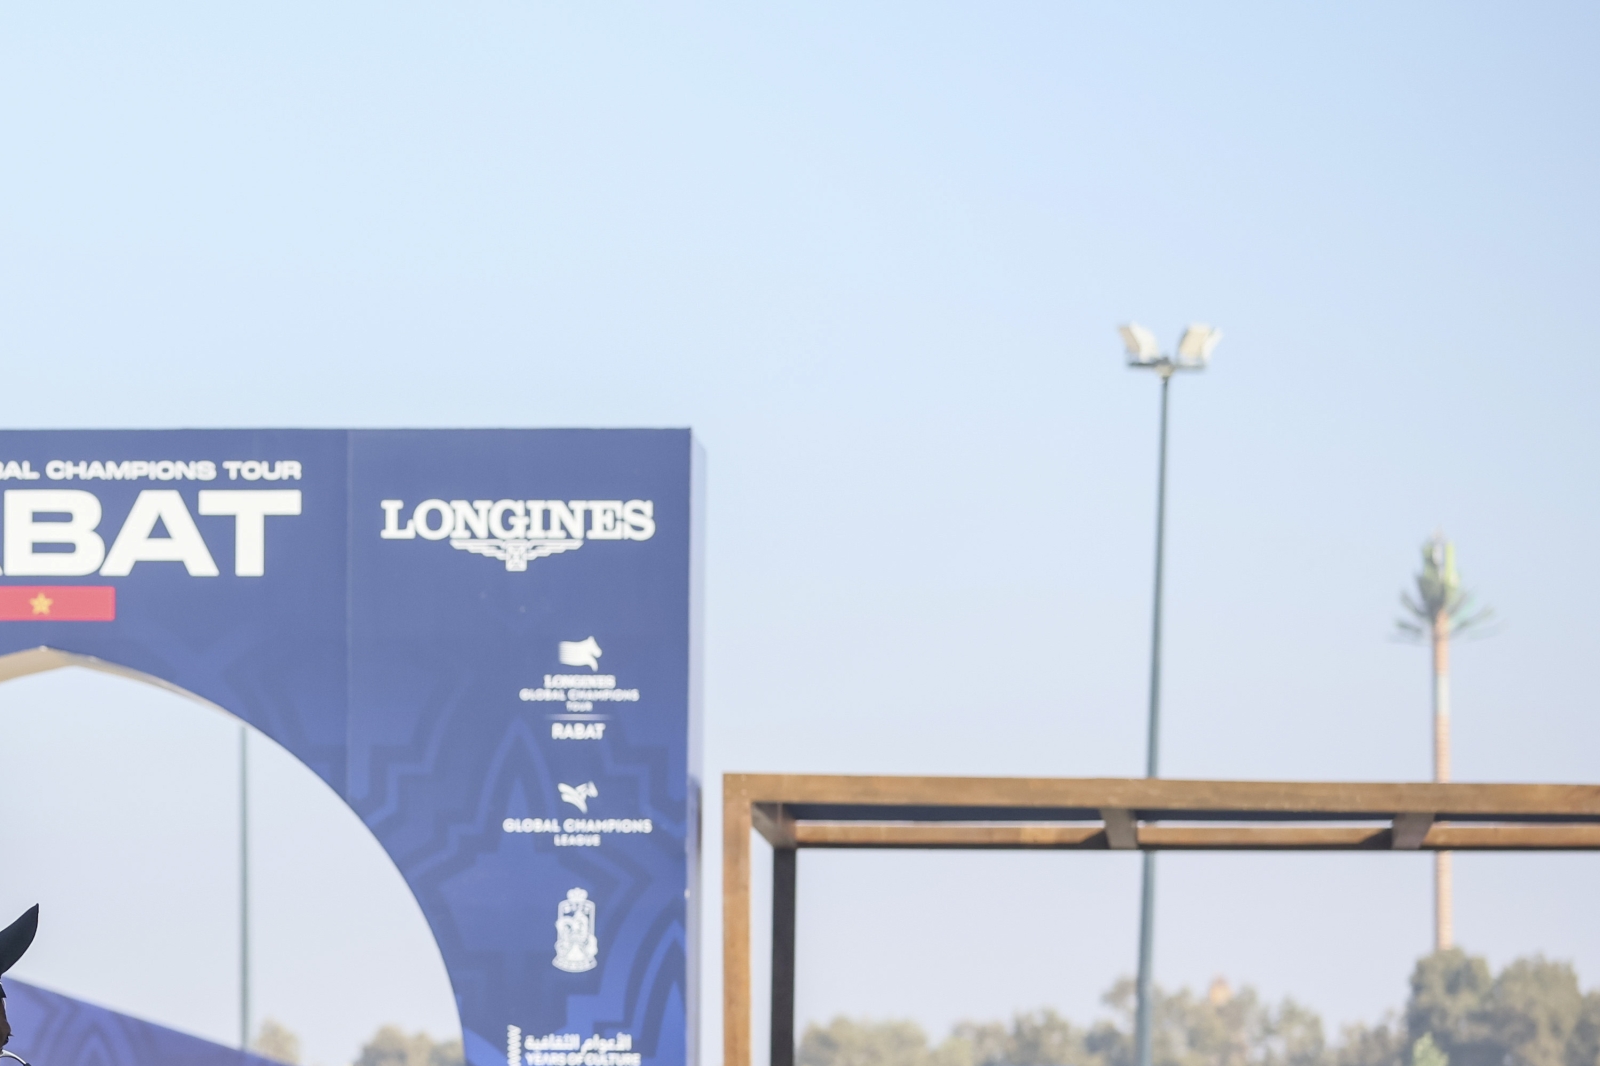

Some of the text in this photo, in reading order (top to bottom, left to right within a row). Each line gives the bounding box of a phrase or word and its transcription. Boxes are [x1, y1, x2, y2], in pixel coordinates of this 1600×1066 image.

[46, 460, 217, 481] CHAMPIONS
[223, 461, 301, 481] TOUR
[381, 499, 655, 541] LONGINES
[544, 675, 616, 688] LONGINES
[552, 723, 605, 739] RABAT
[503, 819, 653, 833] GLOBAL CHAMPIONS
[554, 834, 600, 846] LEAGUE
